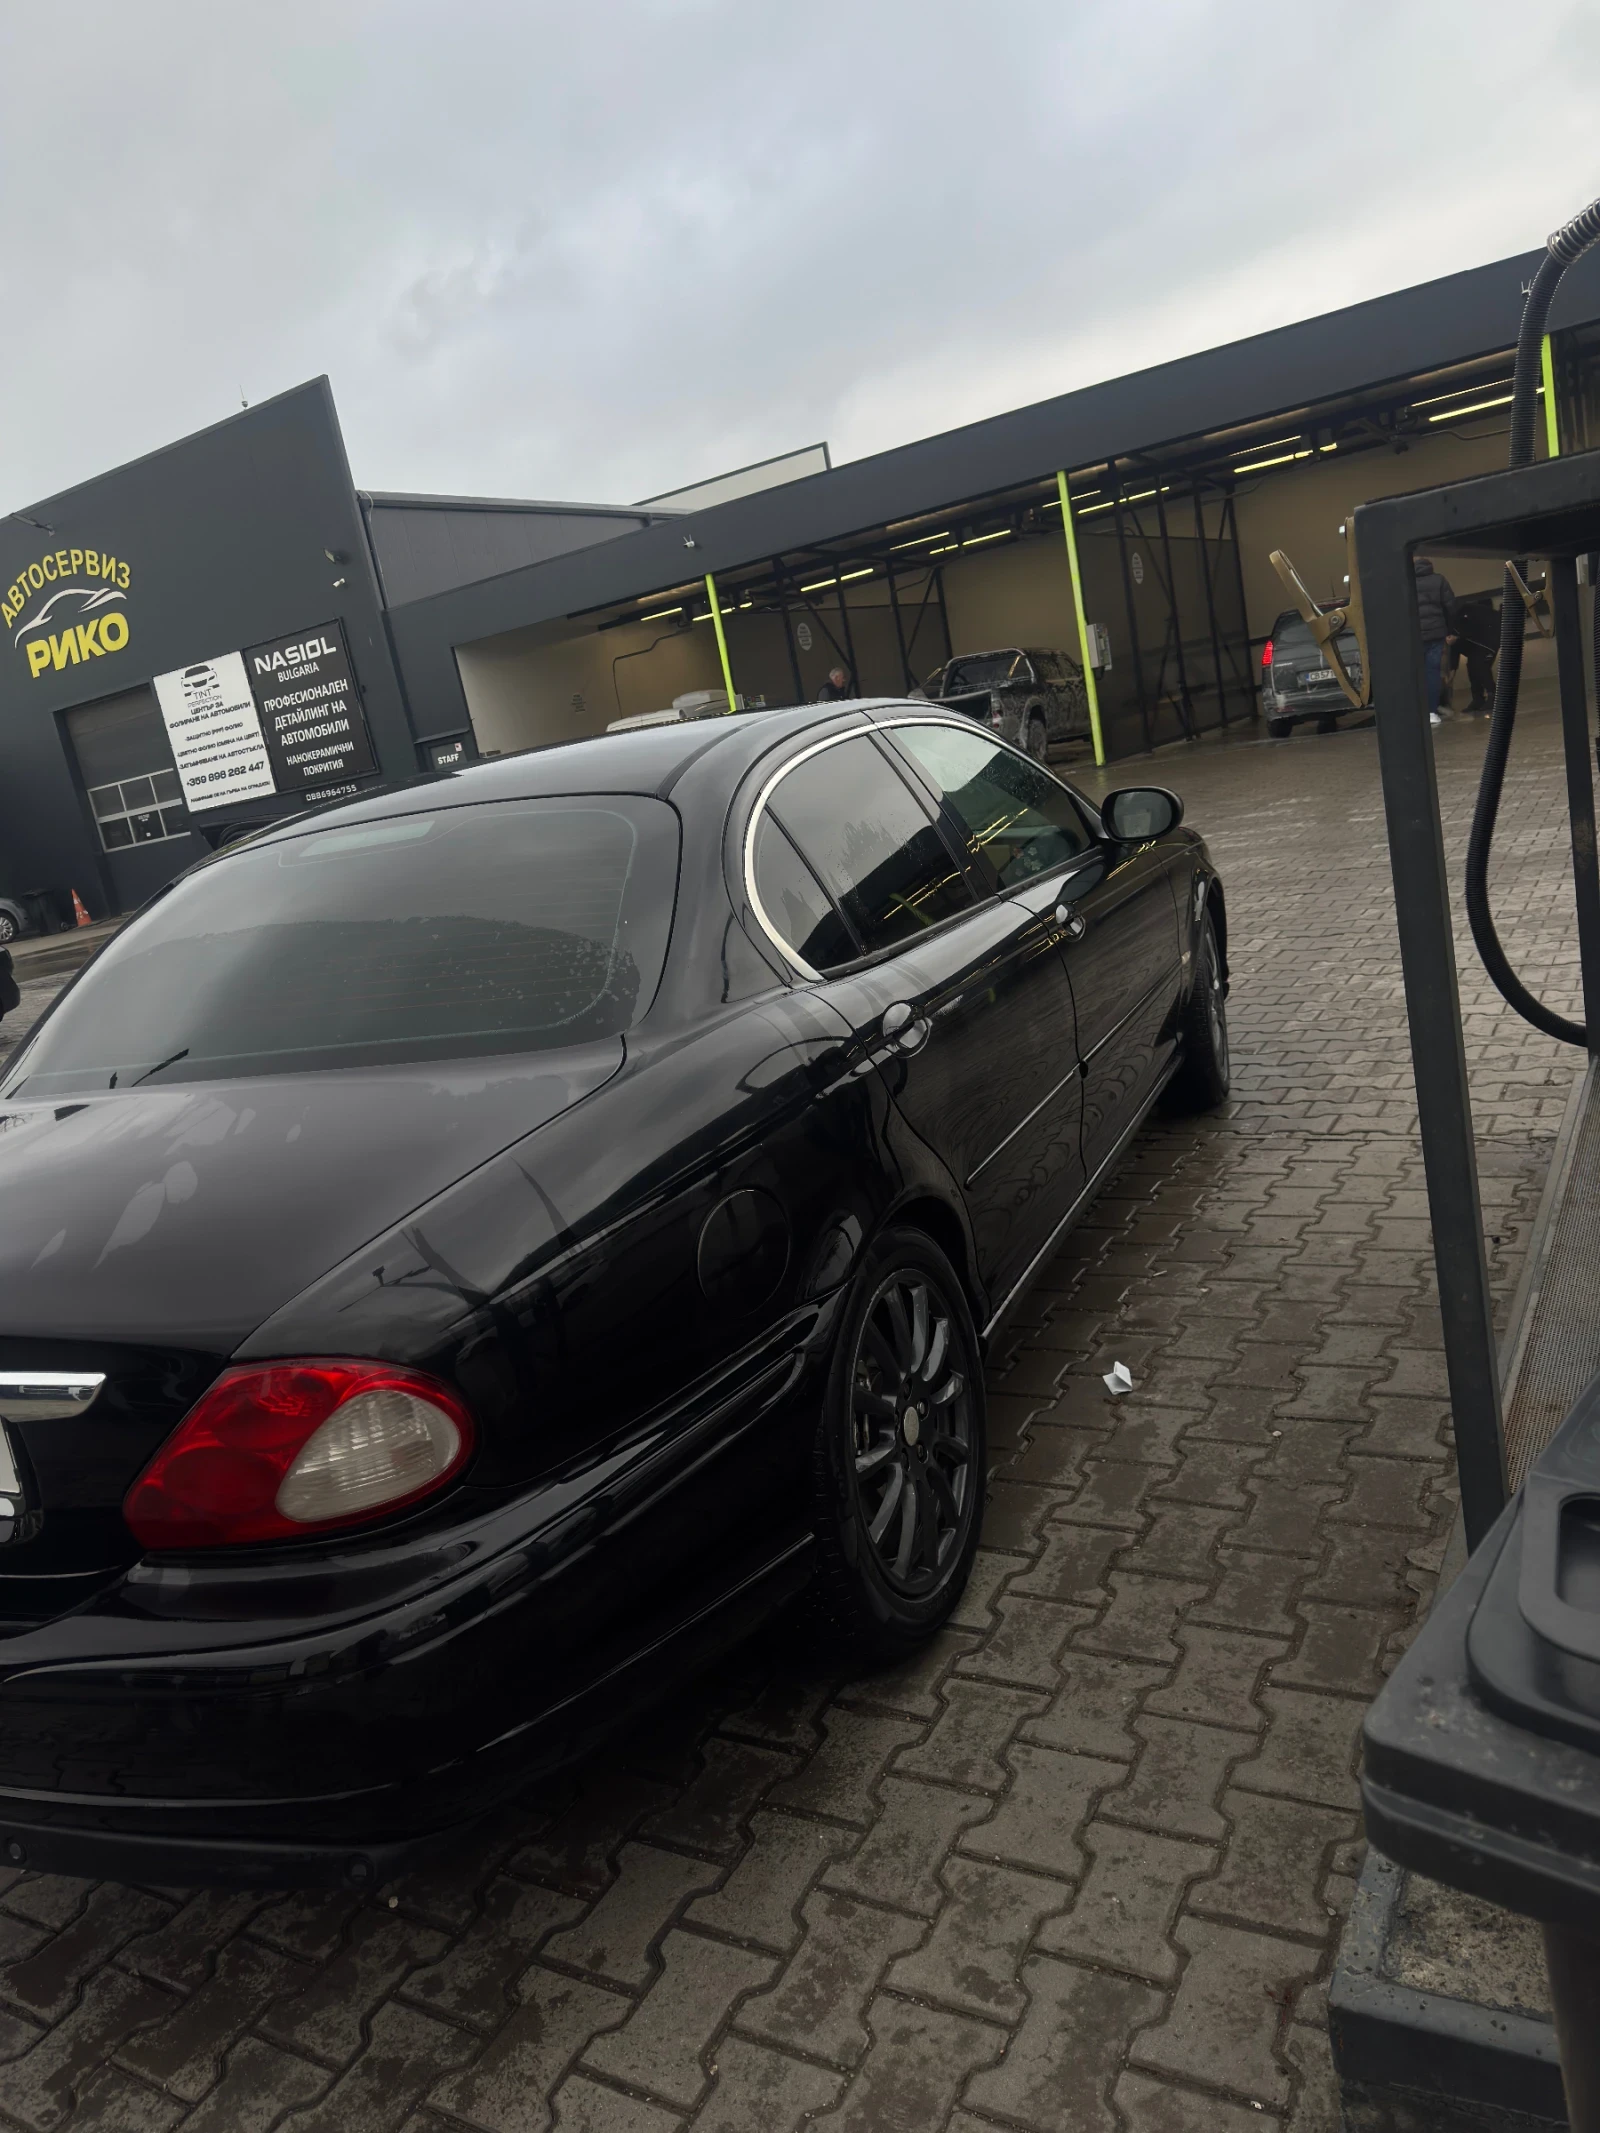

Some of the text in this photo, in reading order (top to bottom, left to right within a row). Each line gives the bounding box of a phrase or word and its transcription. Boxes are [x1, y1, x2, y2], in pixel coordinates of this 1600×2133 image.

[1, 549, 131, 629] АВТОСЕРВИЗ
[26, 612, 129, 678] РИКО
[254, 637, 337, 674] NASIOL
[277, 662, 320, 682] BULGARIA
[187, 695, 222, 708] PERFECTION
[193, 689, 212, 700] TINT
[264, 679, 349, 713] ПРОФЕСИОНАЛЕН
[169, 716, 200, 728] ФОЛИРАНЕ
[210, 701, 251, 717] АВТОМОБИЛИ
[191, 701, 224, 715] ЦЕНТЪР ЗА
[275, 700, 347, 732] ДЕТАЙЛИНГ НА
[281, 719, 350, 746] АВТОМОБИЛИ
[286, 741, 355, 766] НАНОКЕРАМИЧНИ
[437, 753, 459, 765] STAFF
[186, 775, 207, 787] +359
[208, 770, 227, 782] 898
[248, 761, 264, 772] 447
[303, 759, 344, 776] ПОКРИТИЯ
[306, 784, 357, 801] 0886964755
